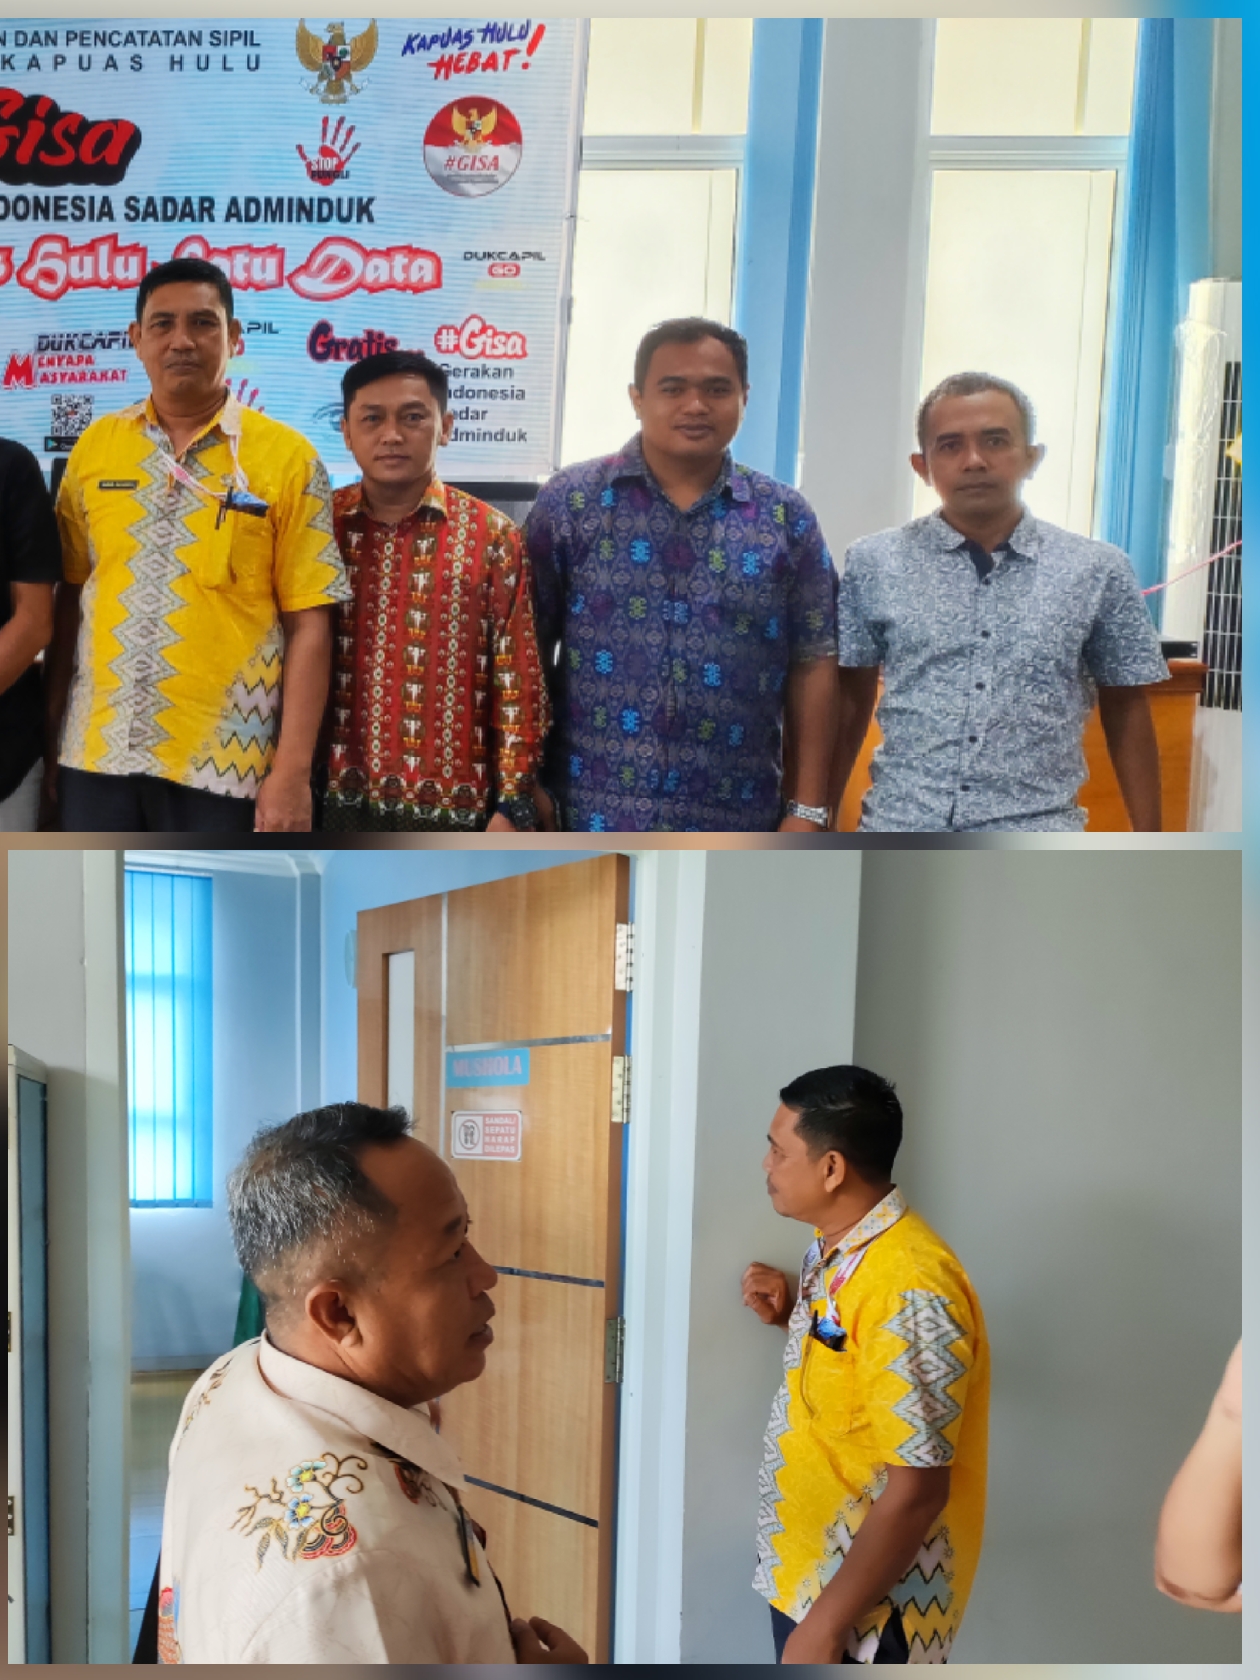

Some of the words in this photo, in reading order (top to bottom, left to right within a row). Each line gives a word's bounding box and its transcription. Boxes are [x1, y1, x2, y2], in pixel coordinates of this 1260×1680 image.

[14, 30, 58, 47] DAN
[65, 30, 203, 48] PENCATATAN
[209, 30, 261, 47] SIPIL
[401, 26, 475, 57] KAPUAS
[477, 19, 531, 44] HULU
[0, 53, 144, 72] KAPUAS
[169, 53, 261, 72] HULU
[444, 154, 500, 171] #GISA
[123, 195, 216, 223] SADAR
[224, 195, 376, 224] ADMINDUK
[463, 251, 546, 261] DUKCAPIL
[290, 237, 440, 298] Data
[435, 315, 527, 359] #Gisa
[451, 428, 527, 442] dminduk
[453, 1055, 522, 1077] MUSHOLA
